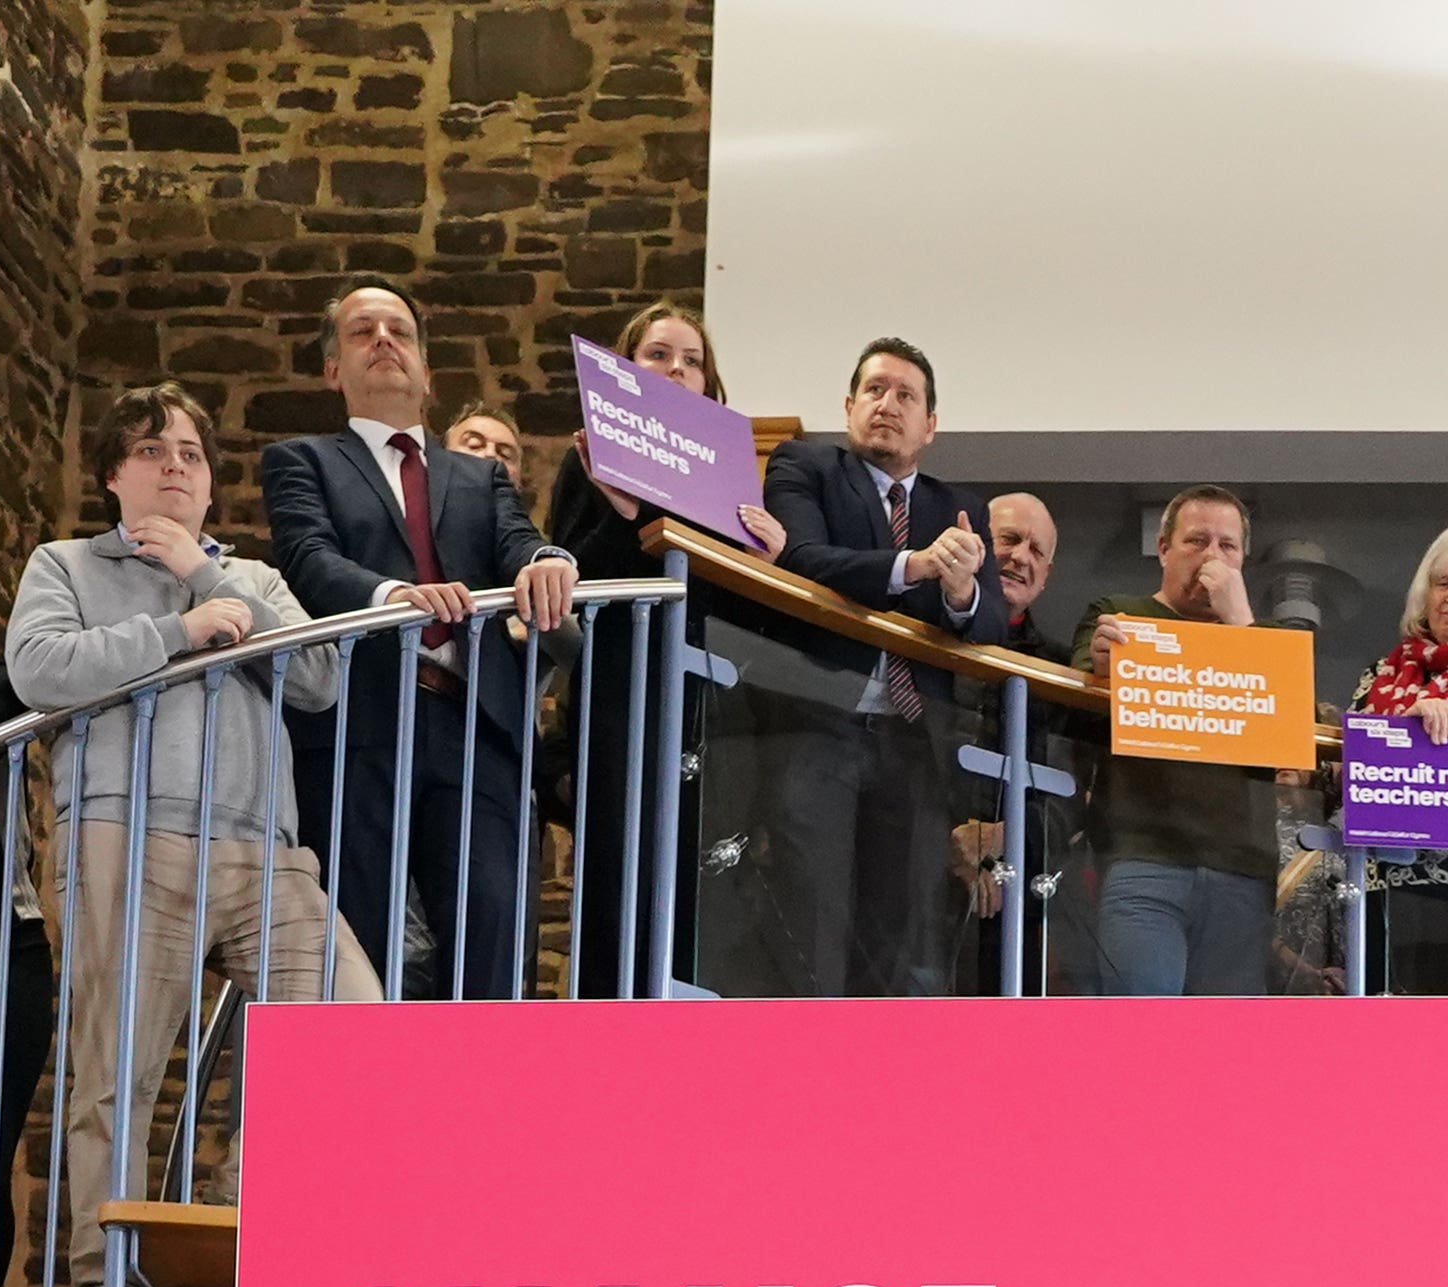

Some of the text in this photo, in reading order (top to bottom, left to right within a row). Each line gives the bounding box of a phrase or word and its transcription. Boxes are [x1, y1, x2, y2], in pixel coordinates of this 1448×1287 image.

[587, 389, 716, 464] Recruit new
[590, 414, 690, 475] teachers
[1117, 659, 1266, 691] Crack down
[1117, 686, 1275, 715] on antisocial
[1118, 705, 1246, 735] behaviour
[1349, 761, 1435, 784] Recruit
